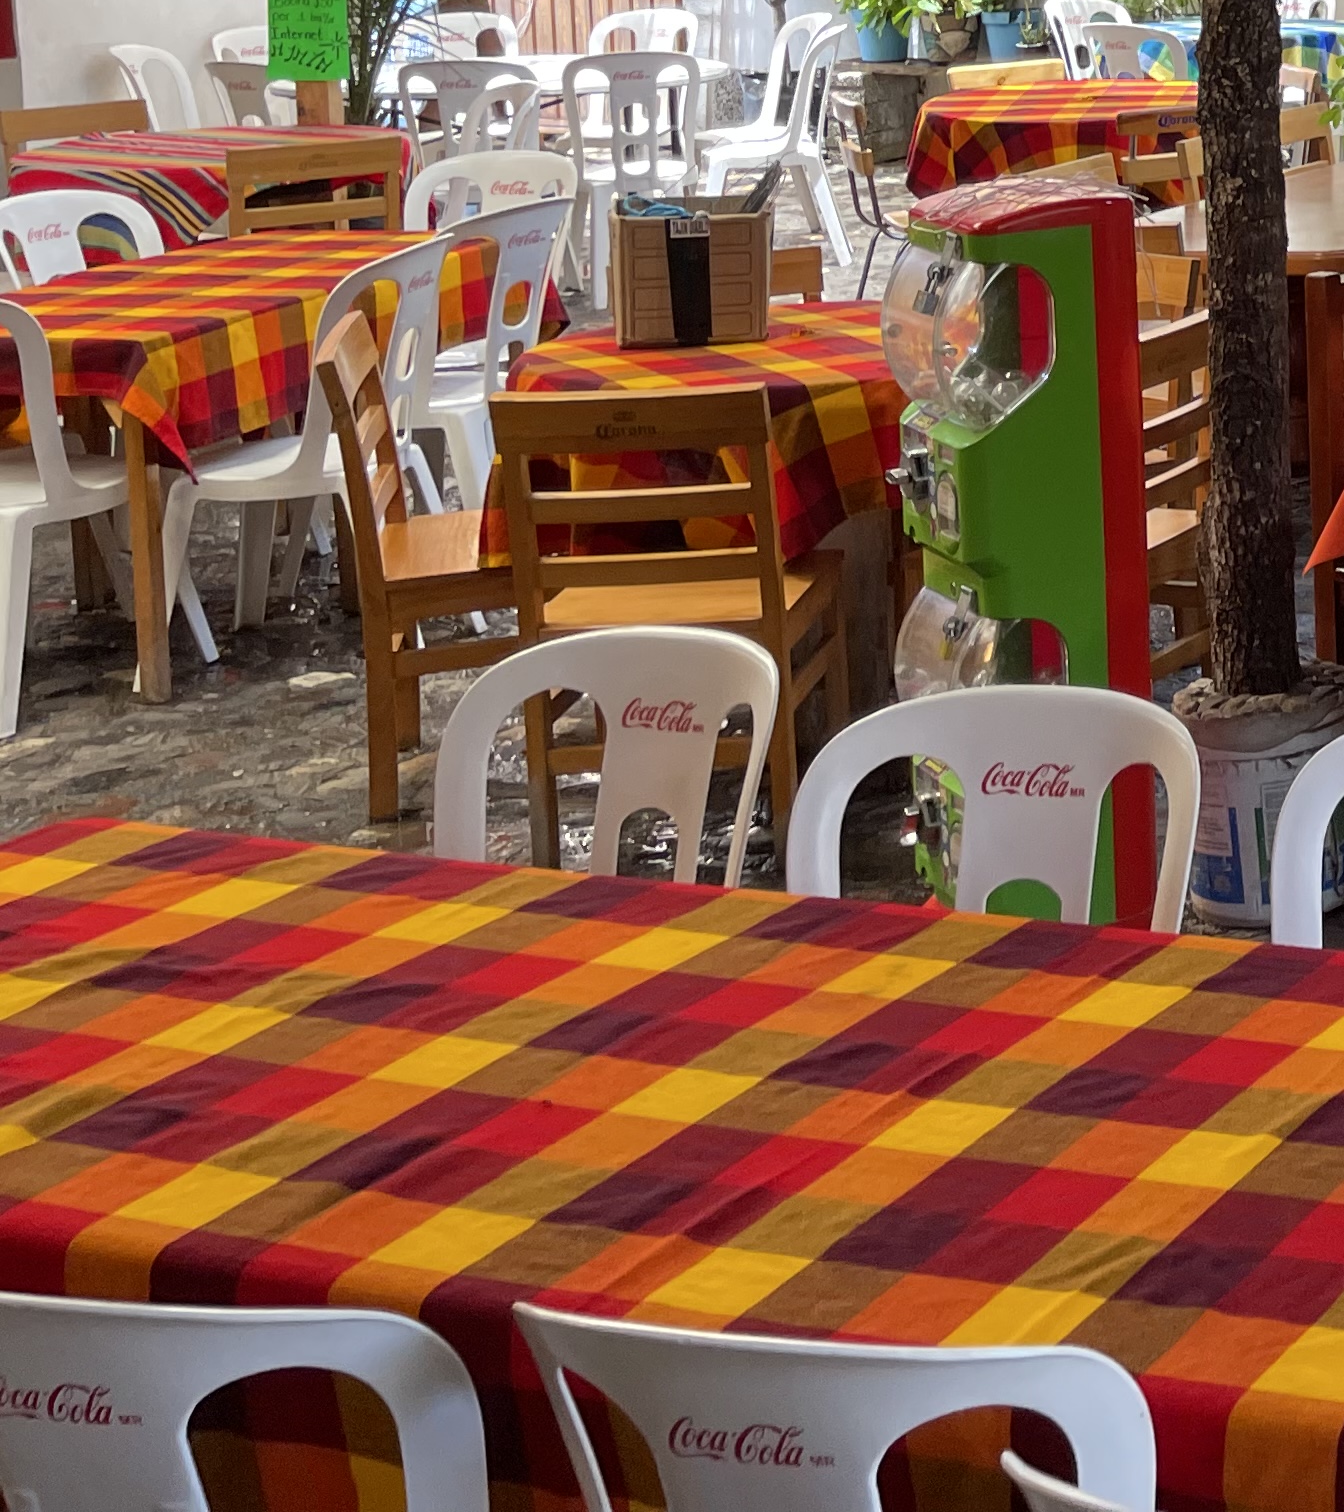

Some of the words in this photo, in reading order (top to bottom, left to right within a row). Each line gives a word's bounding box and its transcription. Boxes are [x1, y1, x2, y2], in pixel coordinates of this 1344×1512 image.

[271, 26, 323, 41] Internet
[1158, 115, 1198, 128] Coron
[490, 181, 529, 196] Coca-Cola
[621, 697, 698, 733] Coca-Cola
[981, 761, 1075, 798] Coca-Cola
[1068, 787, 1085, 797] MR
[668, 1415, 805, 1468] Coca-Cola
